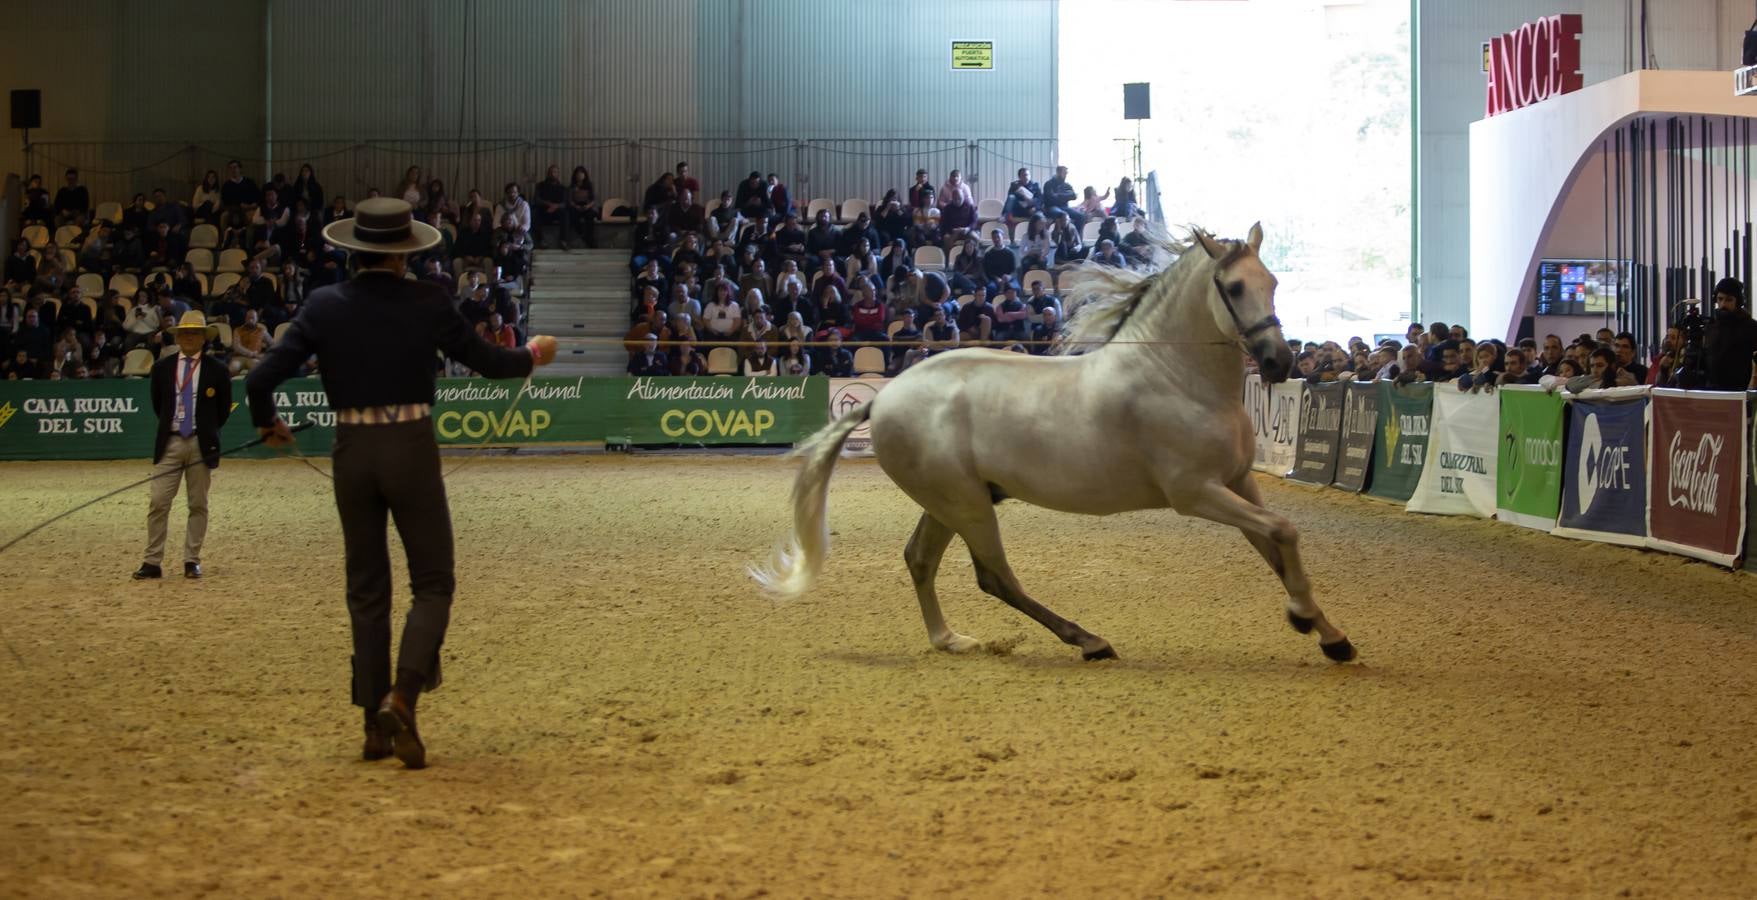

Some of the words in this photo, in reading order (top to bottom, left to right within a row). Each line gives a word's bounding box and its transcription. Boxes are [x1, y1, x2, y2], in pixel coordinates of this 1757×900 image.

[1484, 14, 1563, 118] ANCCE
[434, 381, 509, 402] mentación
[518, 375, 585, 400] Animal
[627, 376, 735, 400] Alimentación
[741, 376, 808, 400] Animal
[23, 398, 70, 415] CAJA
[74, 397, 139, 413] RURAL
[38, 417, 78, 433] DEL
[83, 417, 124, 433] SUR
[437, 408, 551, 439] COVAP
[660, 408, 776, 438] COVAP
[1599, 445, 1631, 490] COPE
